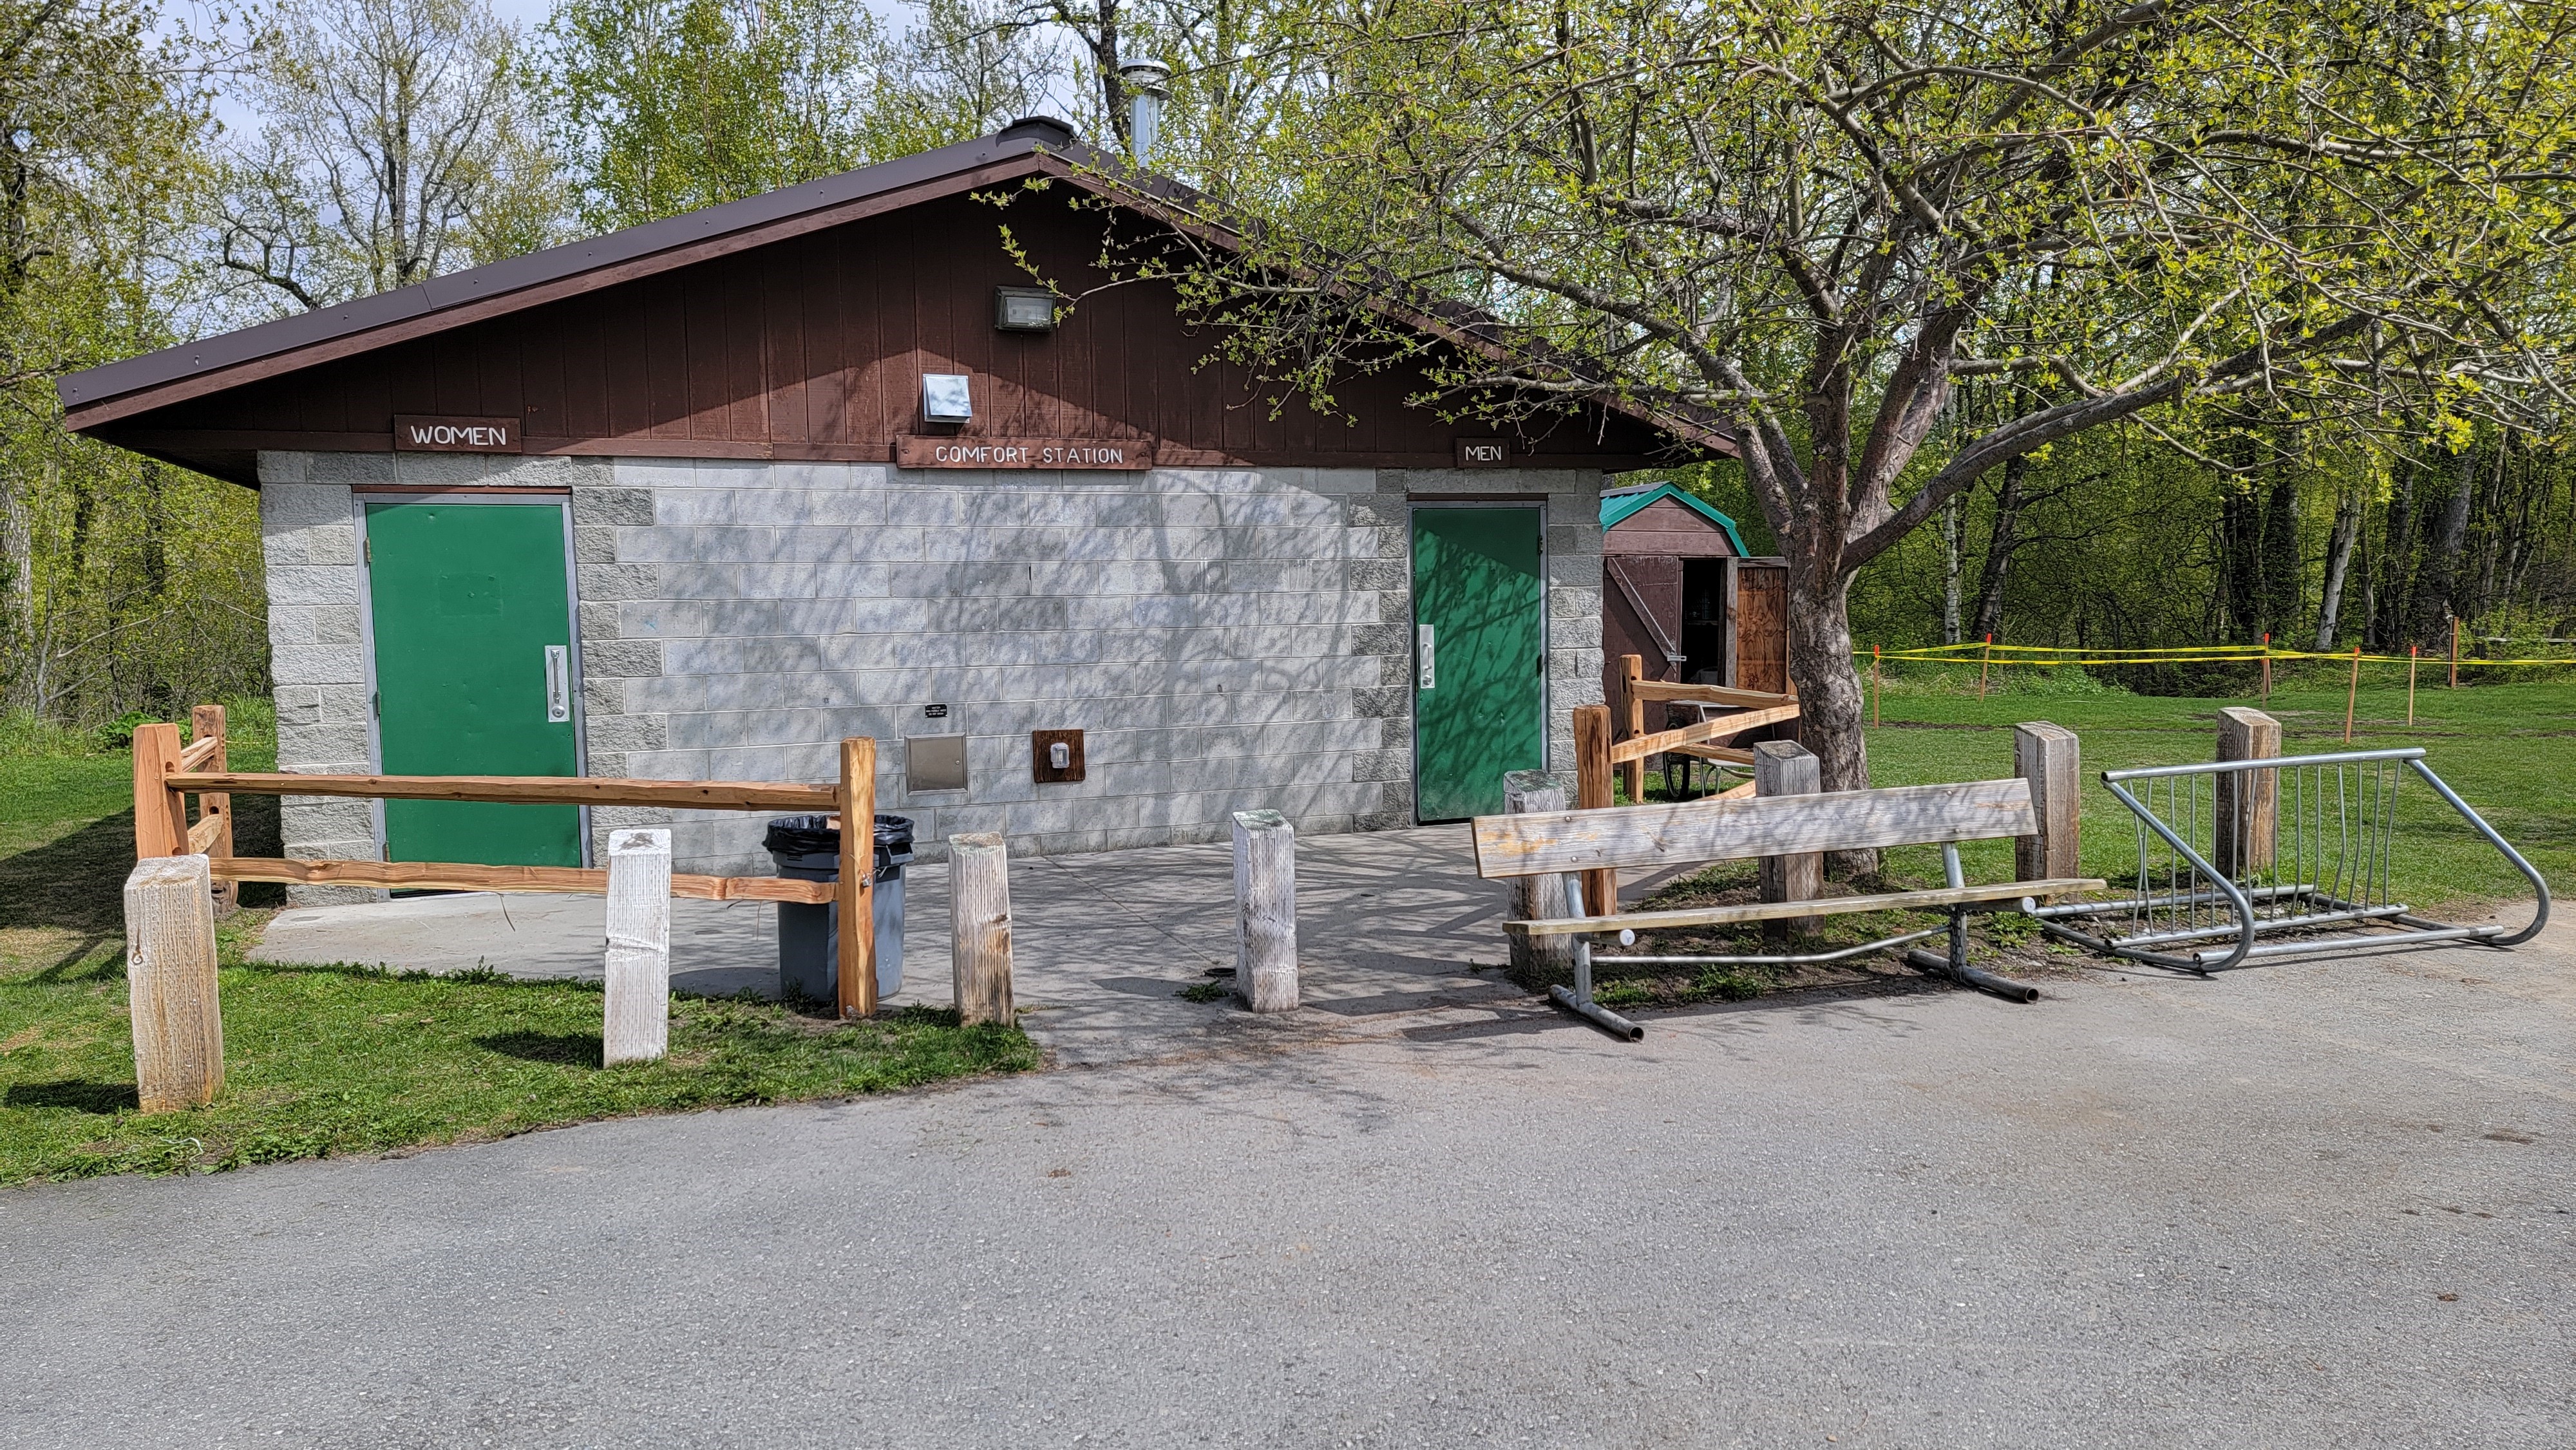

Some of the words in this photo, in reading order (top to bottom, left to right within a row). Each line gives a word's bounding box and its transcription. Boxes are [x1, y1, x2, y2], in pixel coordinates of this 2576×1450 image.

[410, 425, 506, 446] WOMEN
[936, 446, 1030, 463] COMFORT
[1043, 447, 1123, 464] STATION
[1465, 446, 1502, 461] MEN
